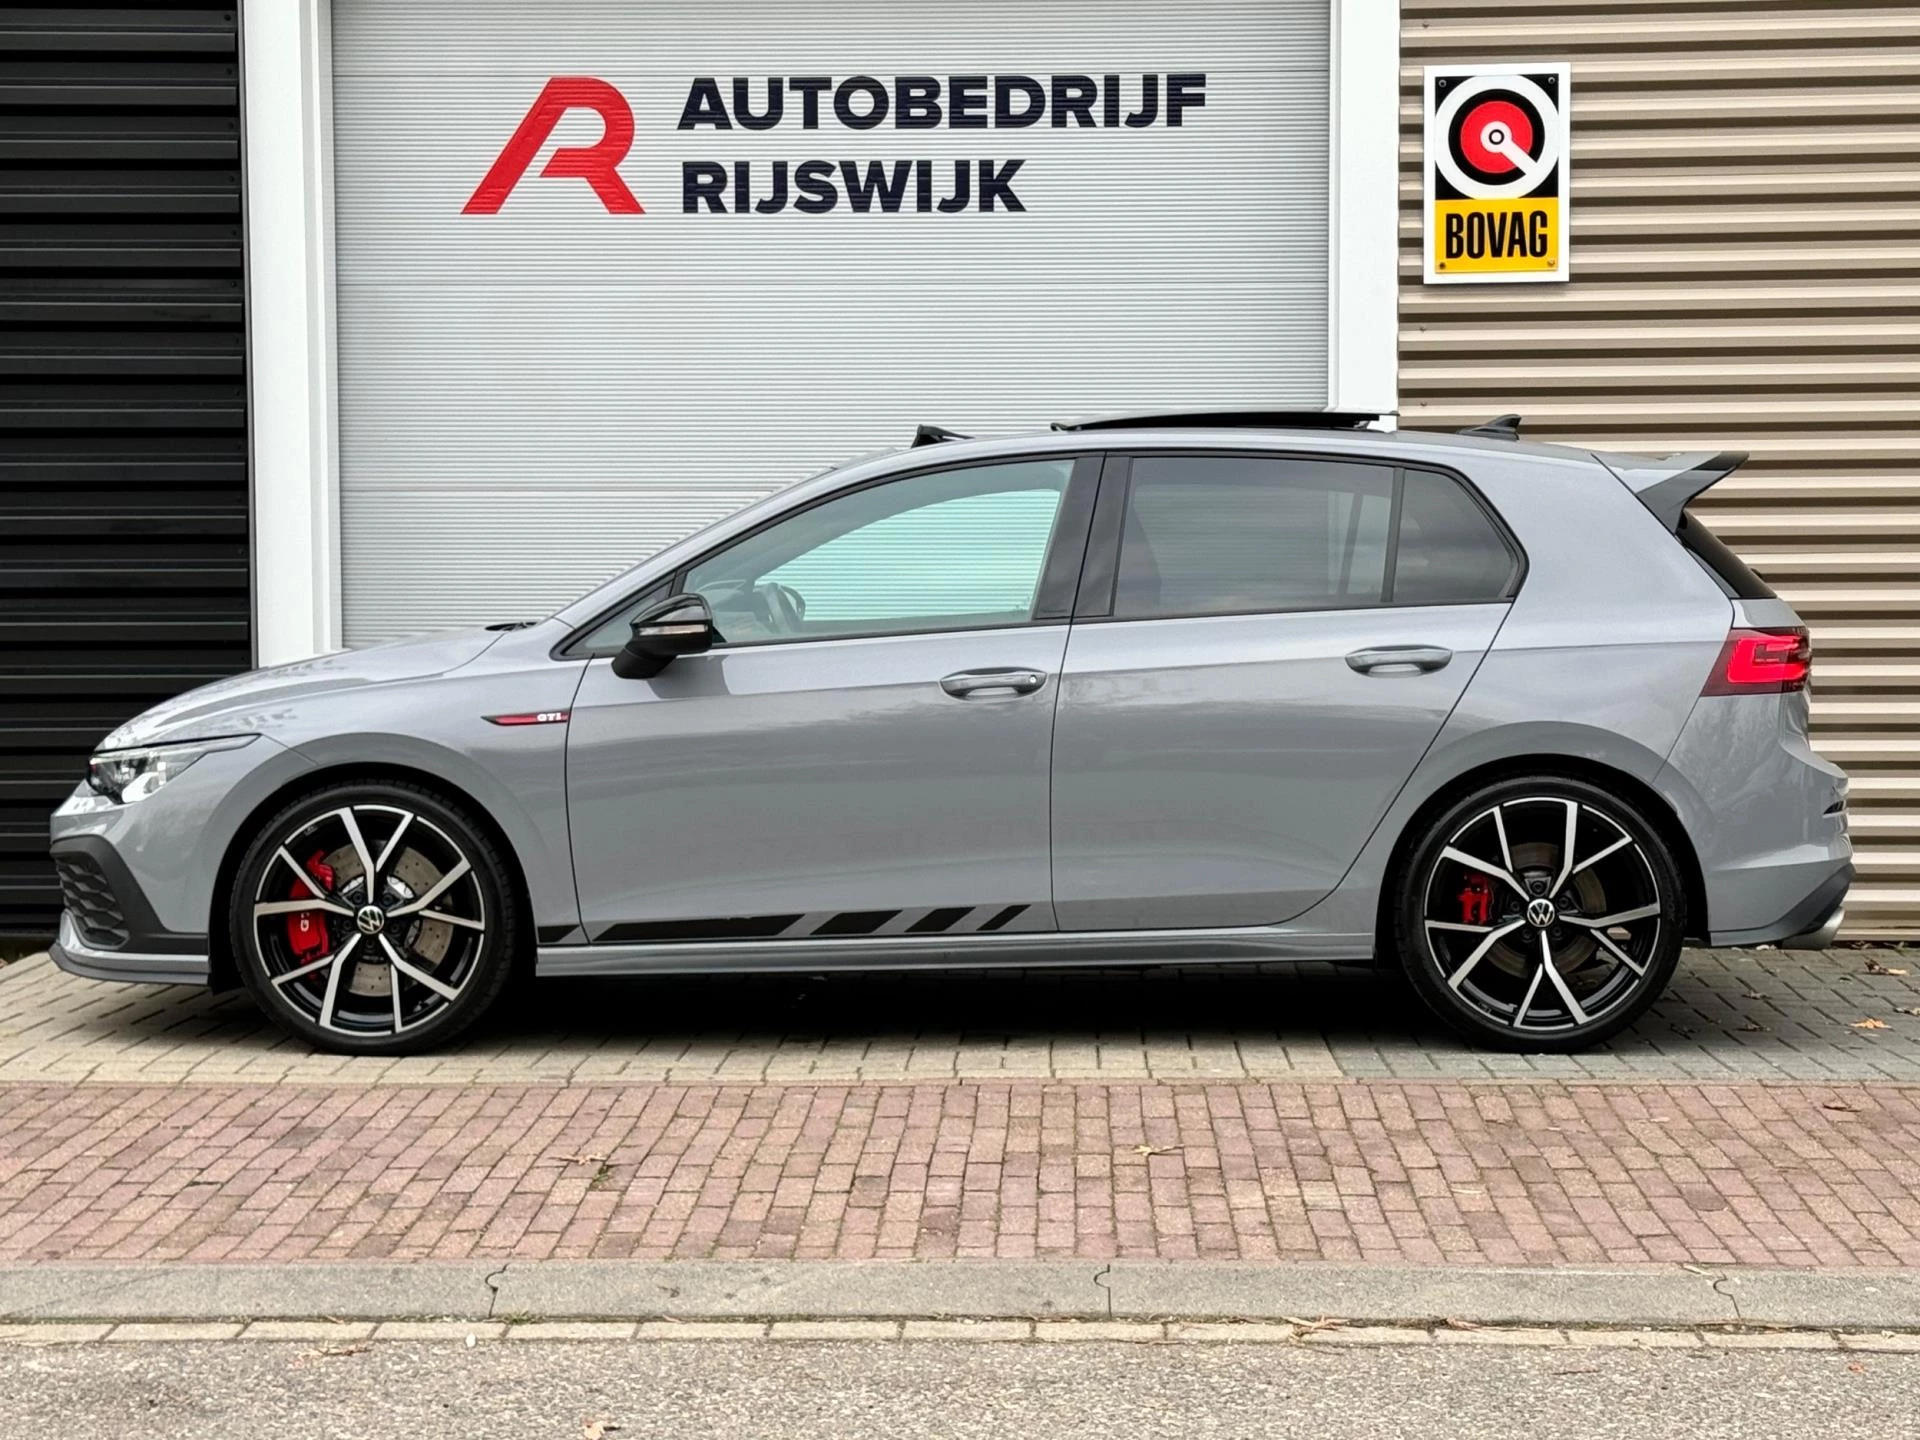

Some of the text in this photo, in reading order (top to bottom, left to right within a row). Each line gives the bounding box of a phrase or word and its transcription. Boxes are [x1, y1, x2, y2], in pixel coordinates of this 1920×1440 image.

[677, 73, 1208, 131] AUTOBEDRIJF
[682, 159, 1027, 214] RIJSWIJK
[1445, 210, 1548, 259] BOVAG
[537, 712, 562, 722] GTI
